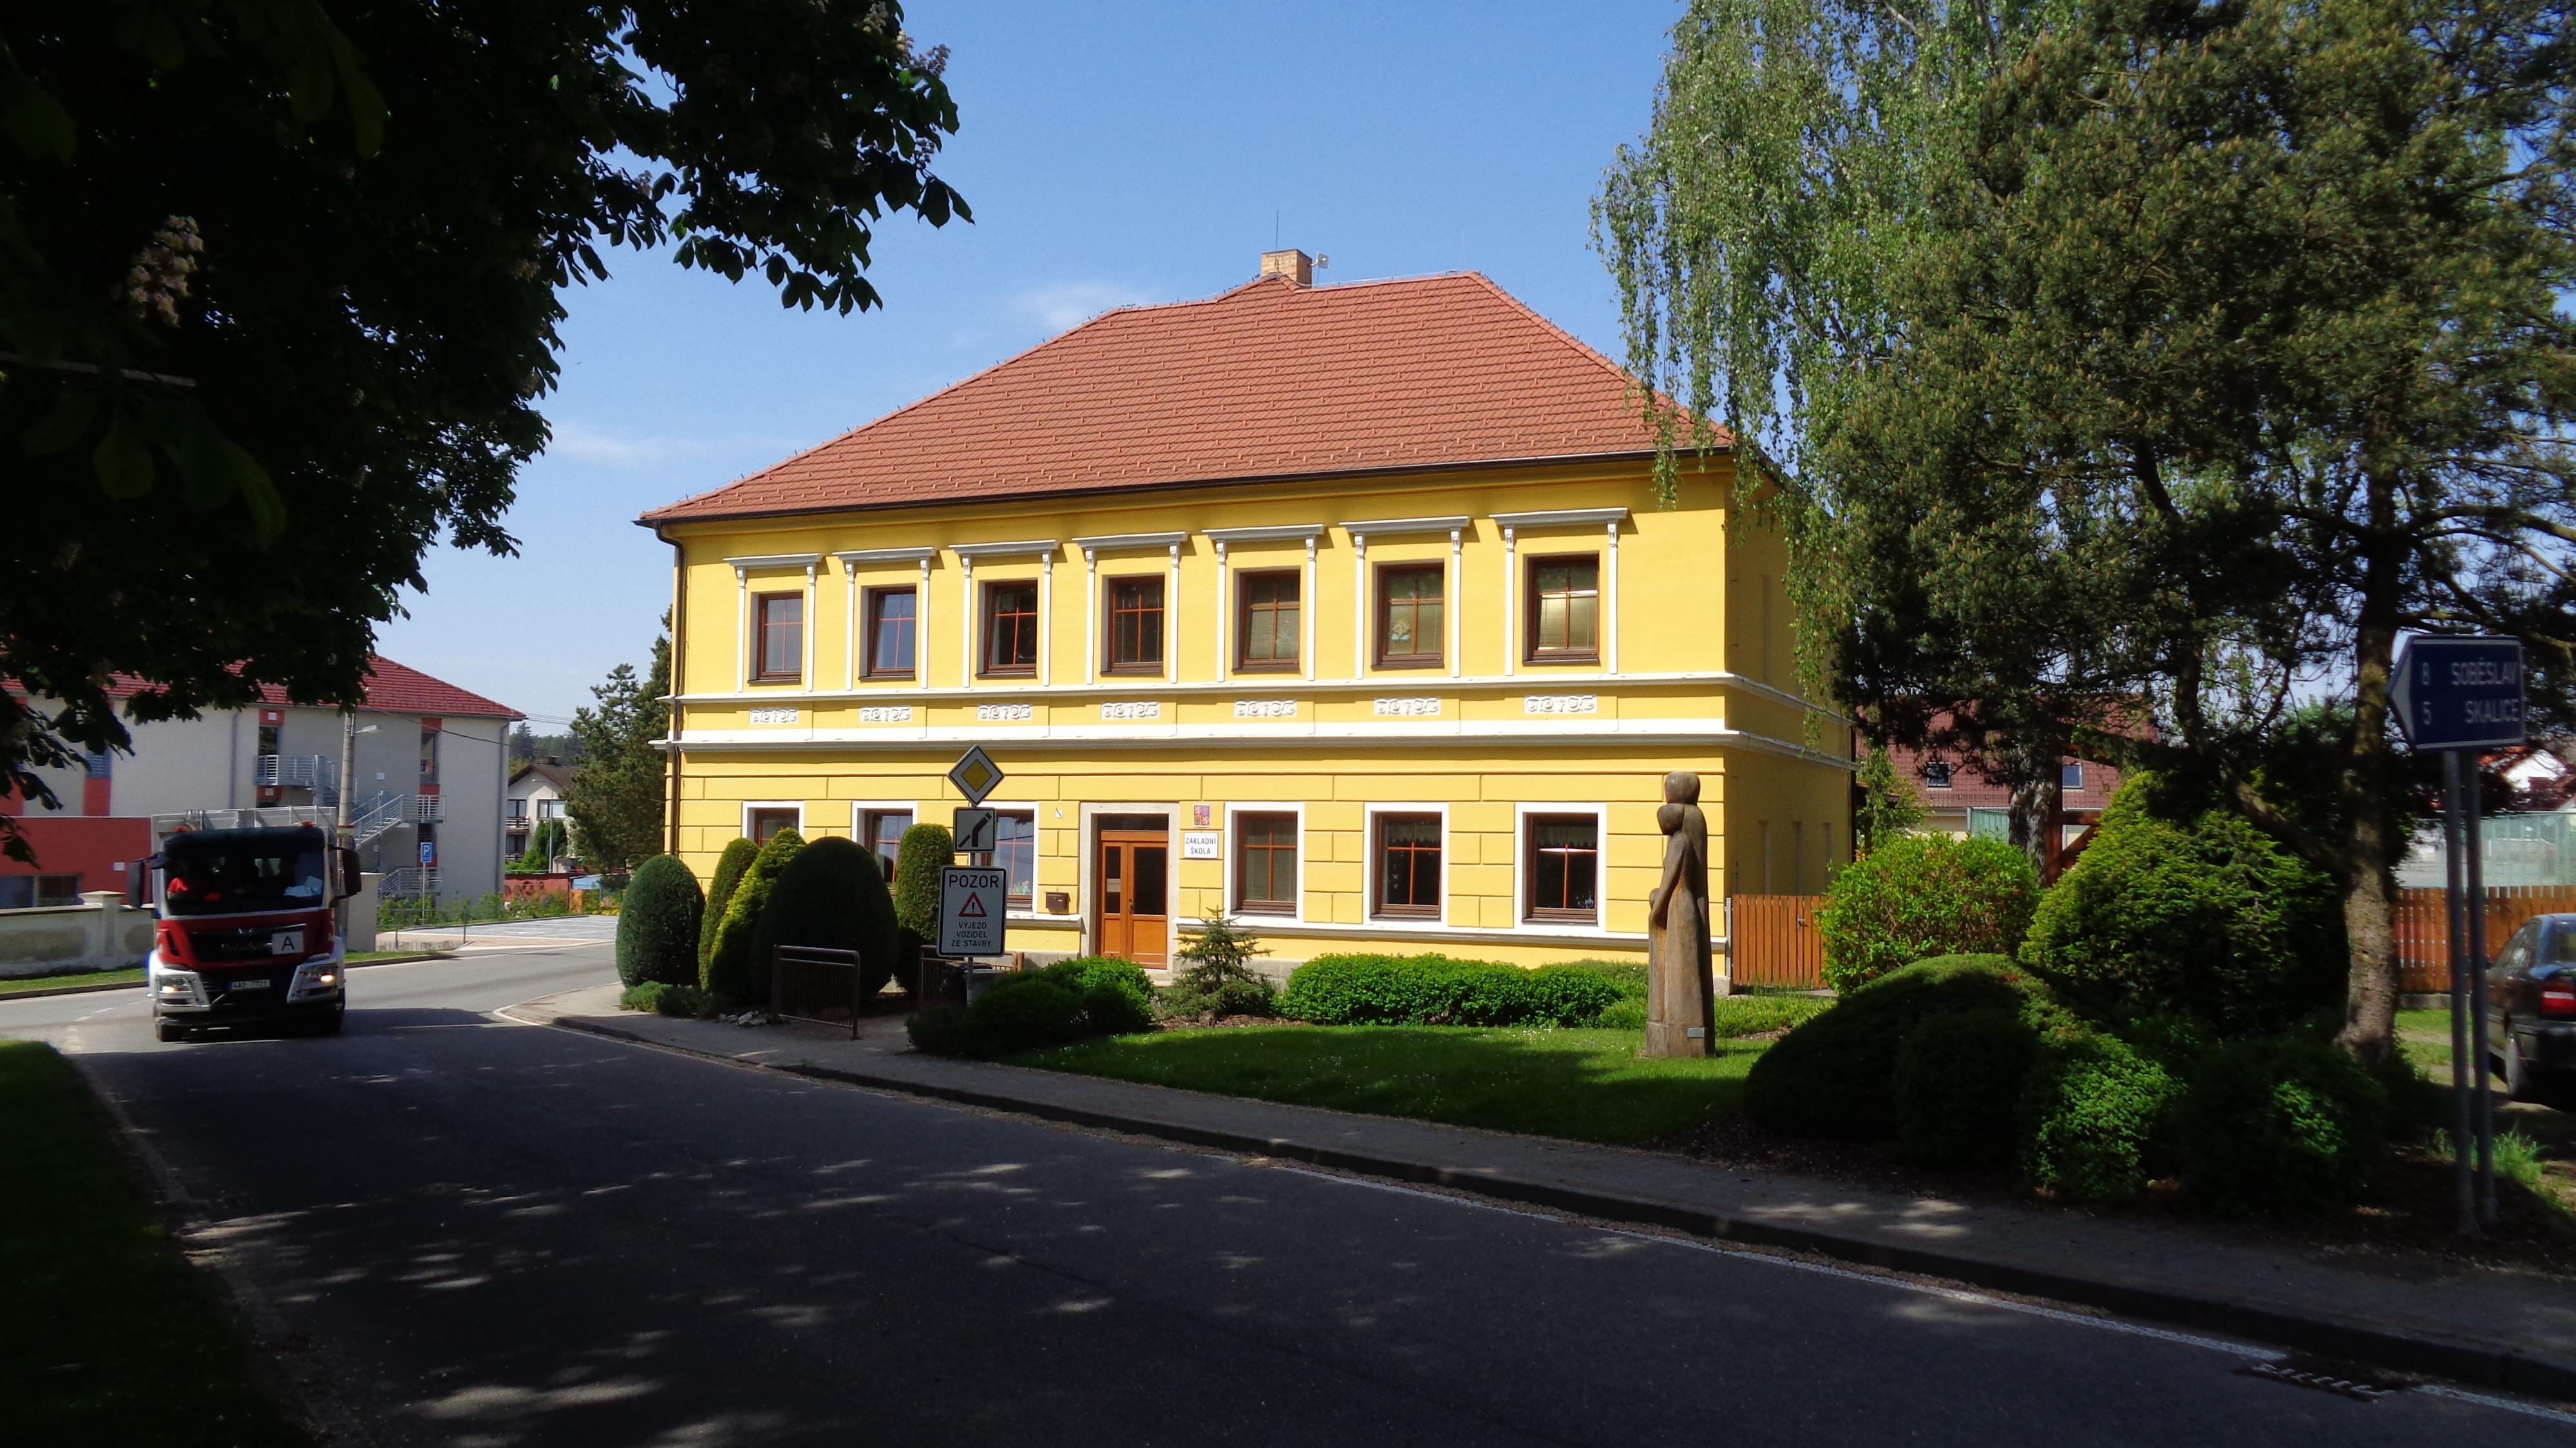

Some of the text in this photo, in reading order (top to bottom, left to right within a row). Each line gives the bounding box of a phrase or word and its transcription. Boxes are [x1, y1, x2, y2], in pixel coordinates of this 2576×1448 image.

[2421, 662, 2430, 686] 8
[2422, 699, 2520, 725] 5 SKALICE
[1186, 835, 1217, 844] ZÁKLADNÍ
[423, 844, 430, 856] P
[1190, 846, 1211, 855] ŠKOLA
[949, 875, 999, 888] POZOR
[281, 935, 295, 951] A
